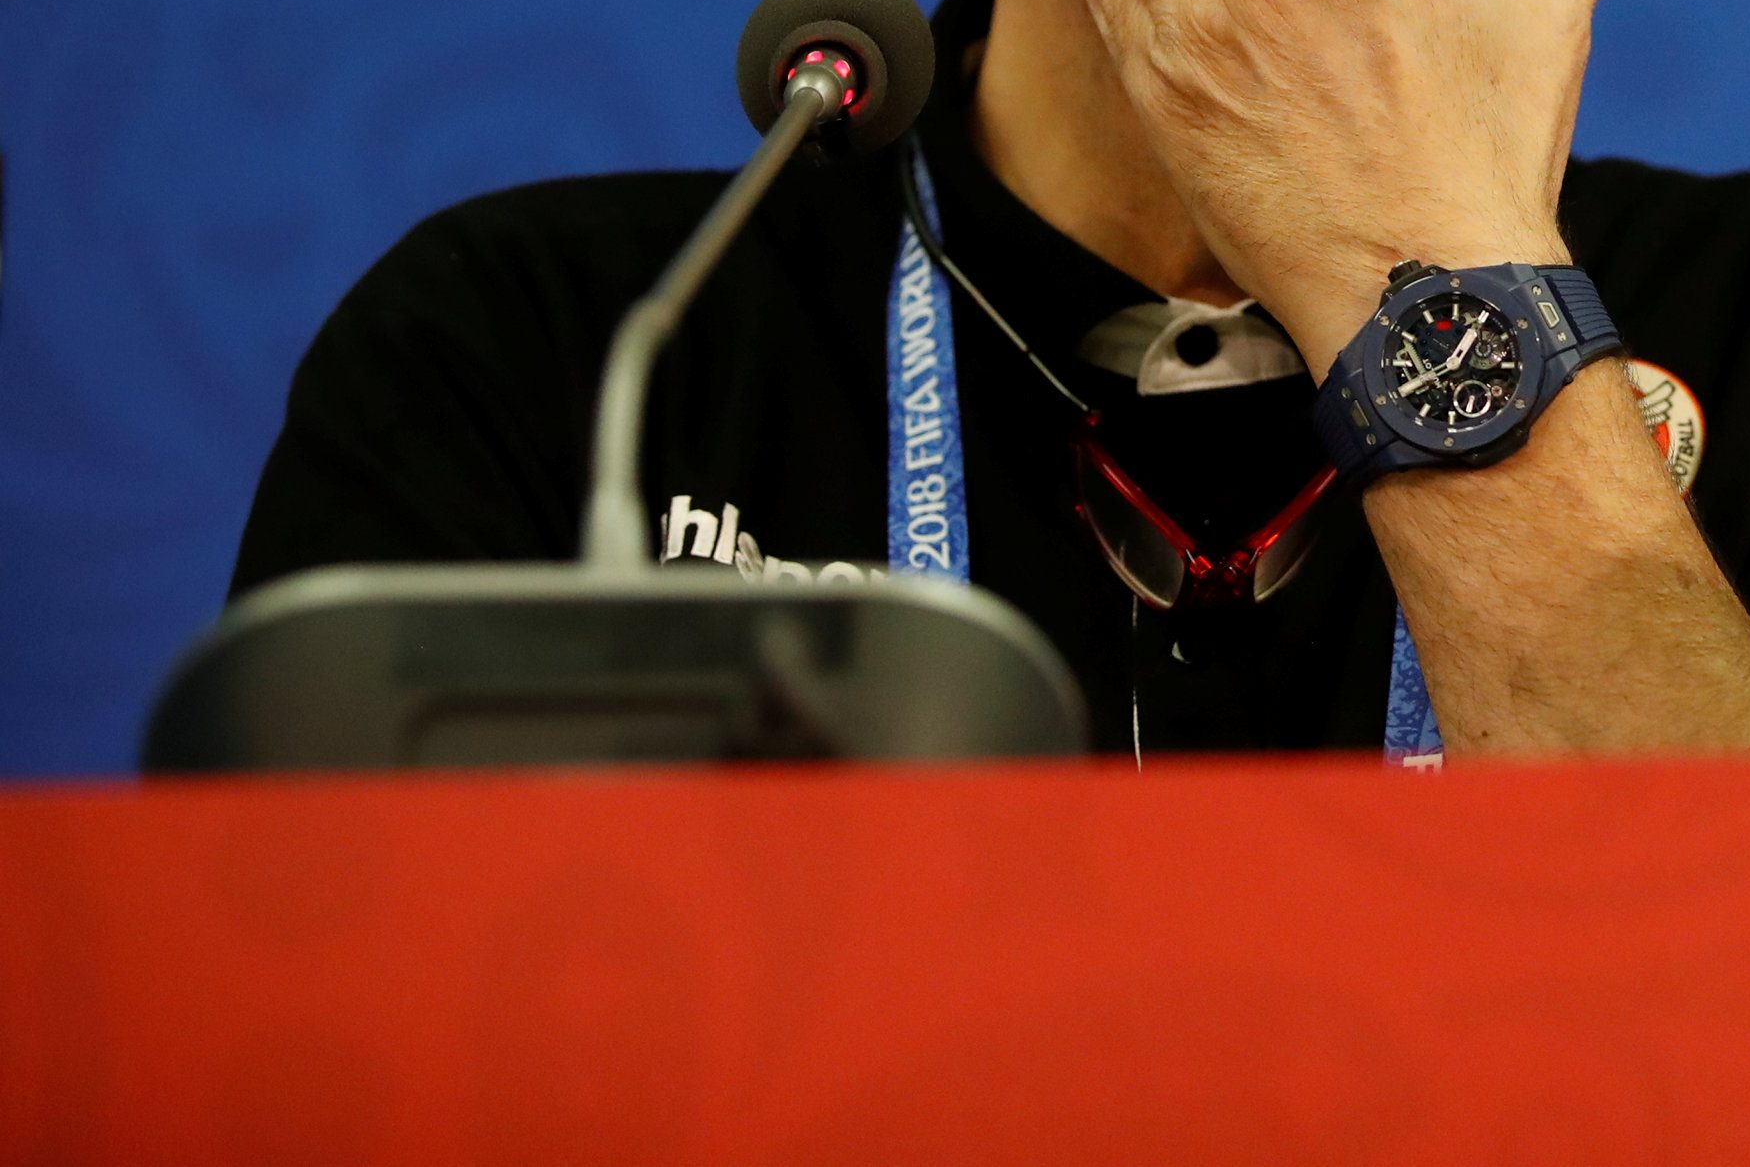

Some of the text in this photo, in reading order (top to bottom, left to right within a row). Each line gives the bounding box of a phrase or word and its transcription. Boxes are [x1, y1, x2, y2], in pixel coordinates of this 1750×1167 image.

[903, 375, 944, 472] FIFA
[1672, 419, 1695, 477] OTBALL
[906, 473, 950, 570] 2018
